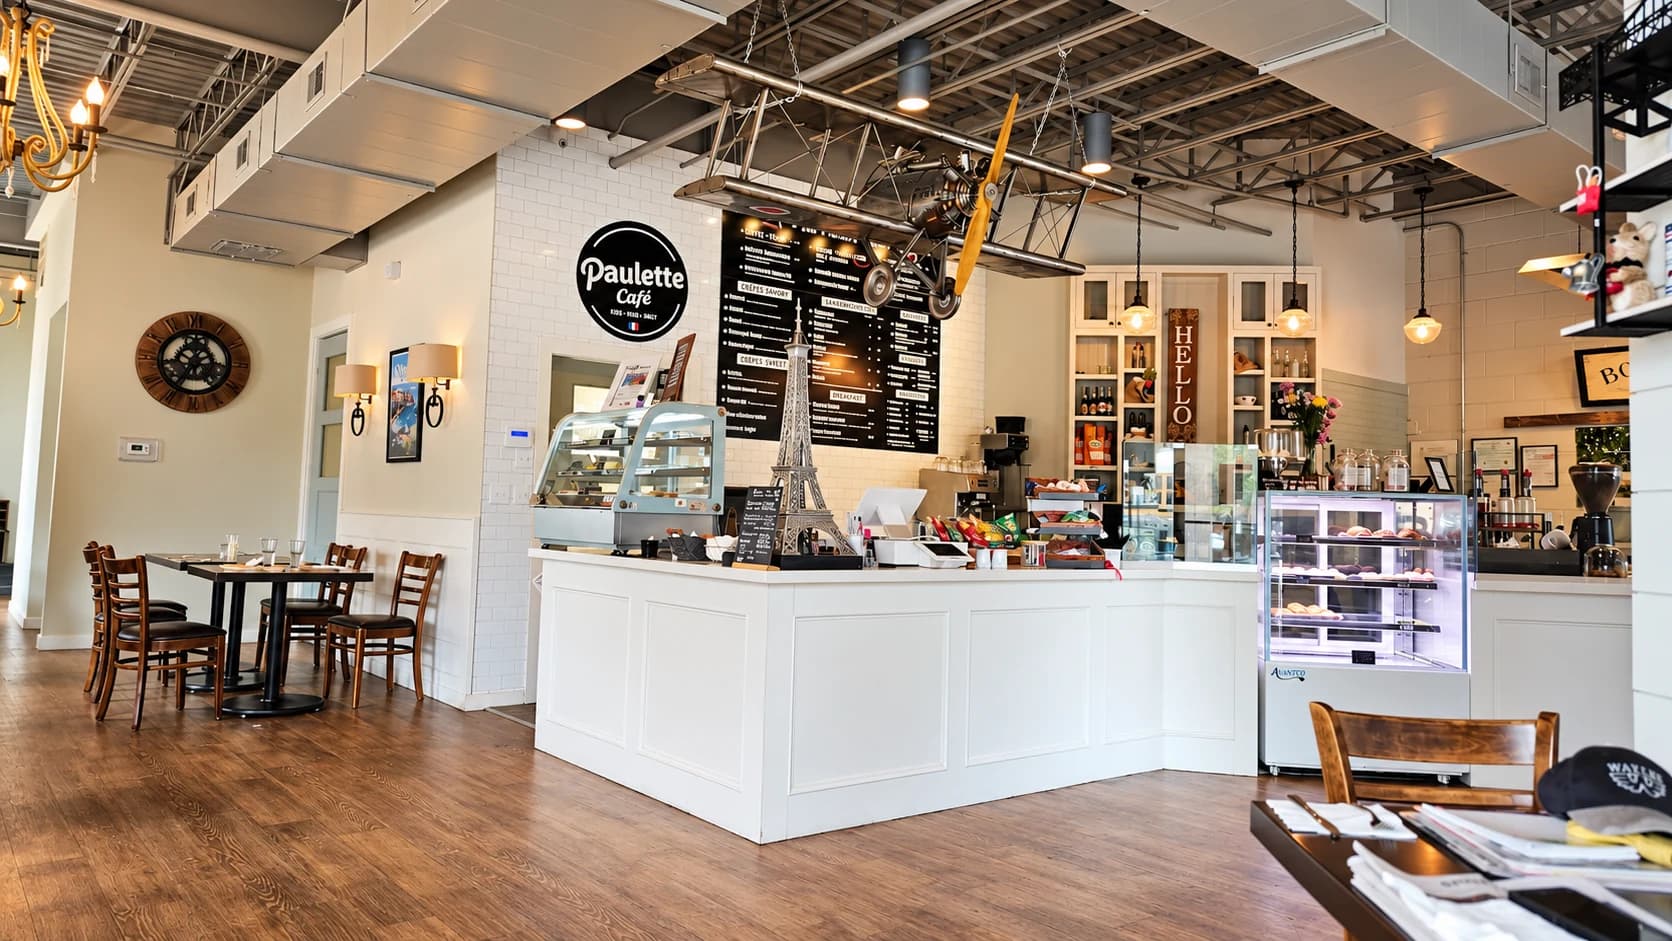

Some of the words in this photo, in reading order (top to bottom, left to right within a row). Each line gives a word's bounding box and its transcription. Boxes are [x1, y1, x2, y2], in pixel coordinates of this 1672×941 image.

[581, 257, 684, 291] Paulette
[616, 288, 652, 309] Café
[1173, 326, 1193, 424] HELLO
